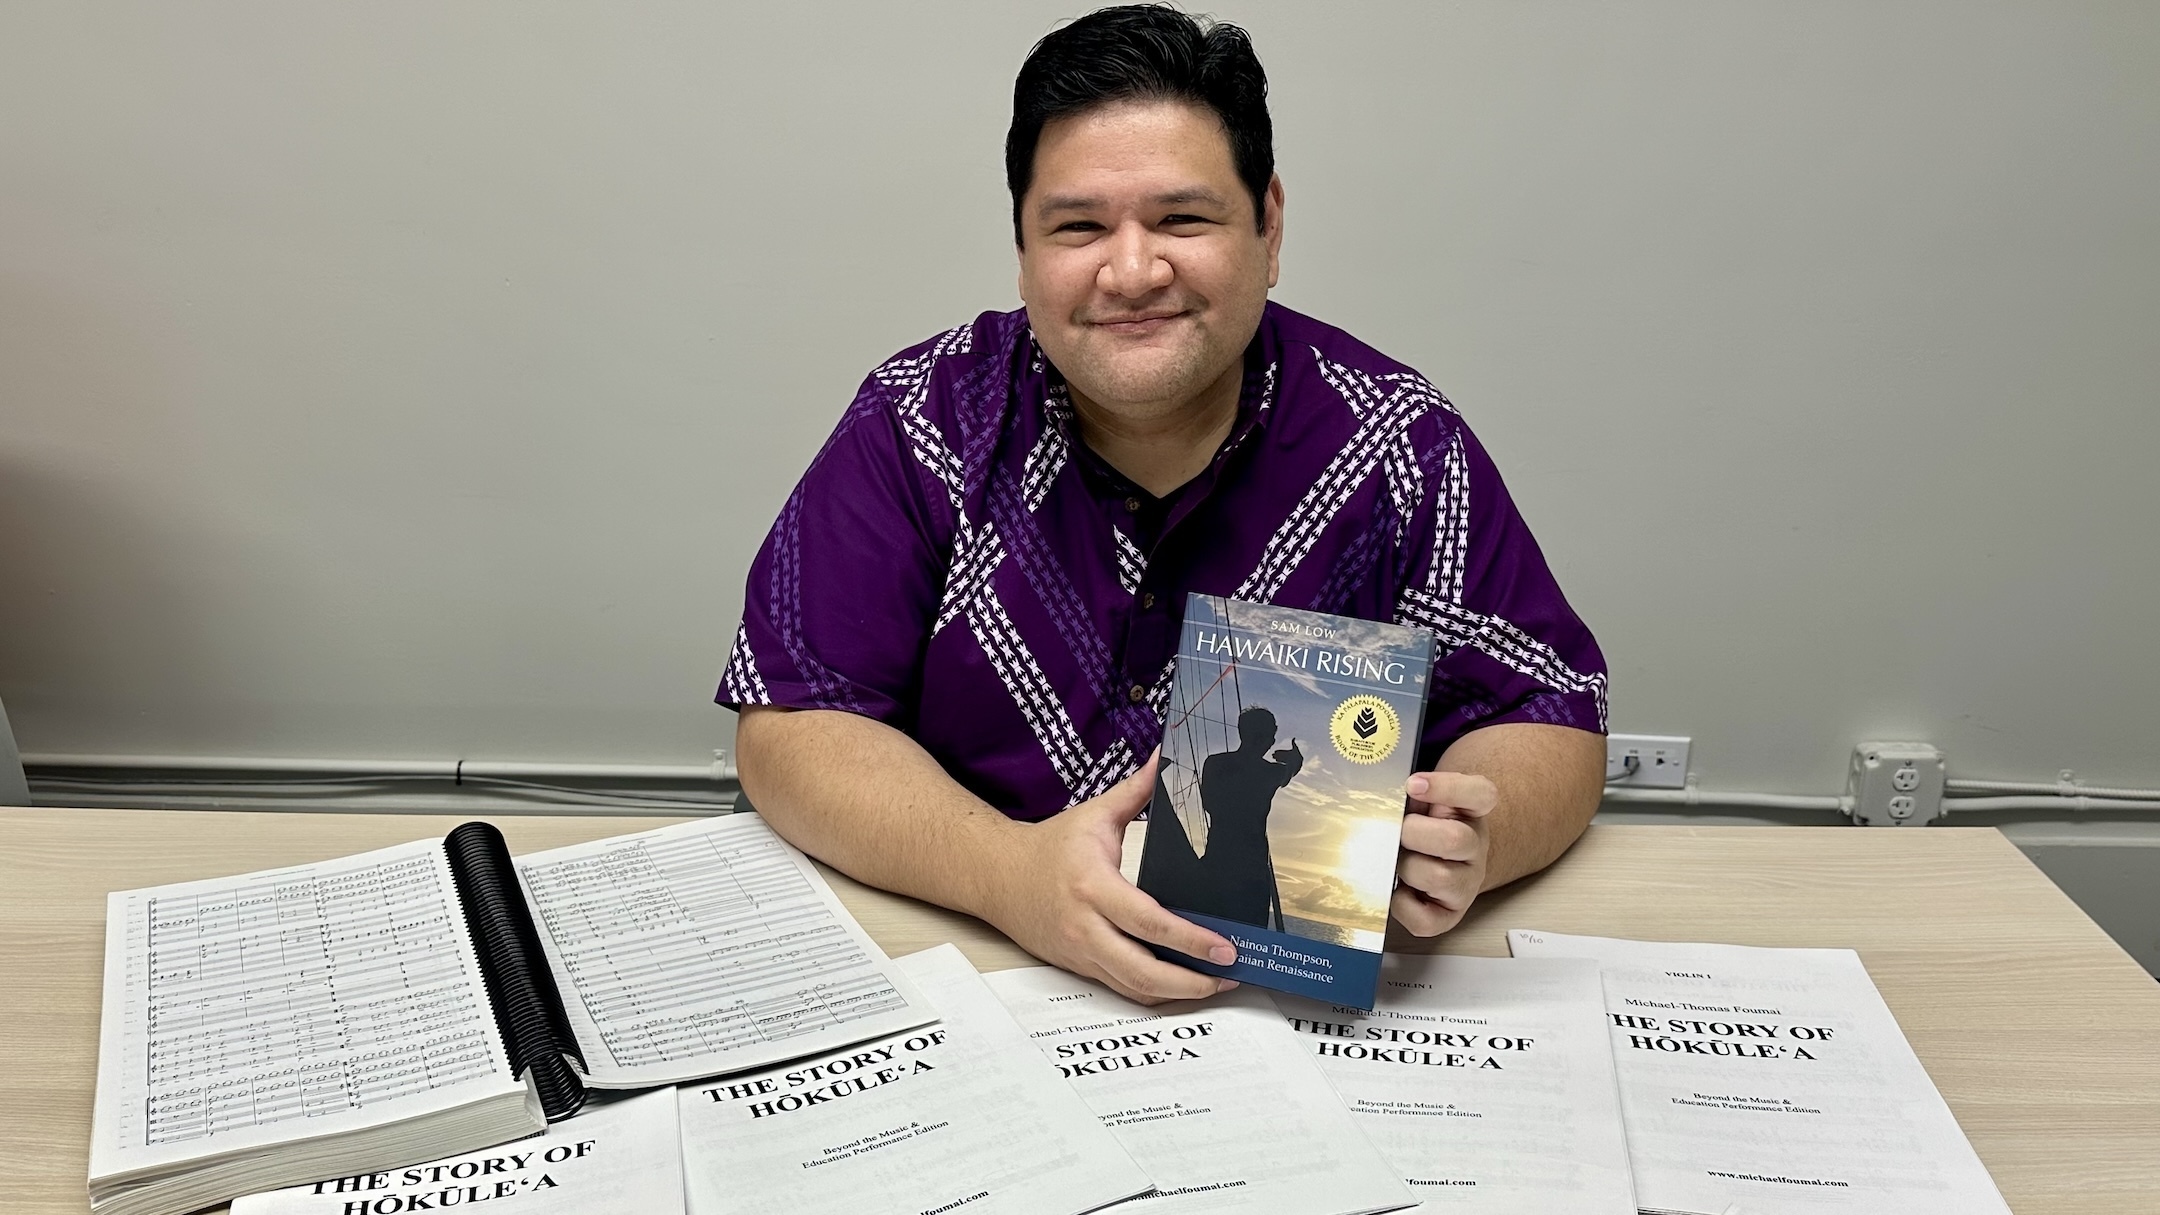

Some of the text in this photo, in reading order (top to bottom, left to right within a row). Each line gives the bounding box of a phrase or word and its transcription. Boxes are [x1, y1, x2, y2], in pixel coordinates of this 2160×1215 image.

[1271, 620, 1336, 639] SAM LOW
[1196, 631, 1406, 685] HAWAIKI RISING
[1337, 712, 1345, 720] KA
[1343, 699, 1375, 712] PALAPALA
[1335, 735, 1347, 752] BOOK
[1348, 751, 1357, 759] OF
[1375, 743, 1390, 757] YEAR
[1230, 935, 1333, 969] Nainoa Thompson,
[1266, 959, 1334, 983] Renaissance
[1665, 971, 1704, 979] VIOLIN
[1387, 981, 1425, 989] VIOLIN
[1048, 994, 1087, 1003] VIOLIN
[1625, 998, 1782, 1015] Michael-Thomas Foumai
[1029, 1012, 1163, 1039] chael-Thomas Foumai
[1332, 1006, 1488, 1025] Michael-Thomas Foumai
[1287, 1018, 1535, 1052] THE STORY OF
[1606, 1013, 1834, 1042] HE STORY OF
[1056, 1022, 1214, 1059] STORY OF
[702, 1030, 947, 1103] THE STORY OF
[1357, 1099, 1394, 1108] Beyond
[1671, 1097, 1821, 1114] Education Performance Edition
[1693, 1092, 1730, 1102] Beyond
[1749, 1097, 1780, 1105] Music
[1116, 1112, 1175, 1126] Performance
[1176, 1107, 1211, 1117] Edition
[1142, 1105, 1172, 1114] Music
[1382, 1108, 1443, 1116] Performance
[802, 1120, 949, 1169] Education Performance Edition
[823, 1139, 861, 1155] Beyond
[862, 1134, 877, 1144] the
[878, 1125, 909, 1139] Music
[401, 1152, 535, 1187] STORY
[544, 1139, 596, 1163] OF
[1707, 1170, 1849, 1188] www.michaelfoumai.com
